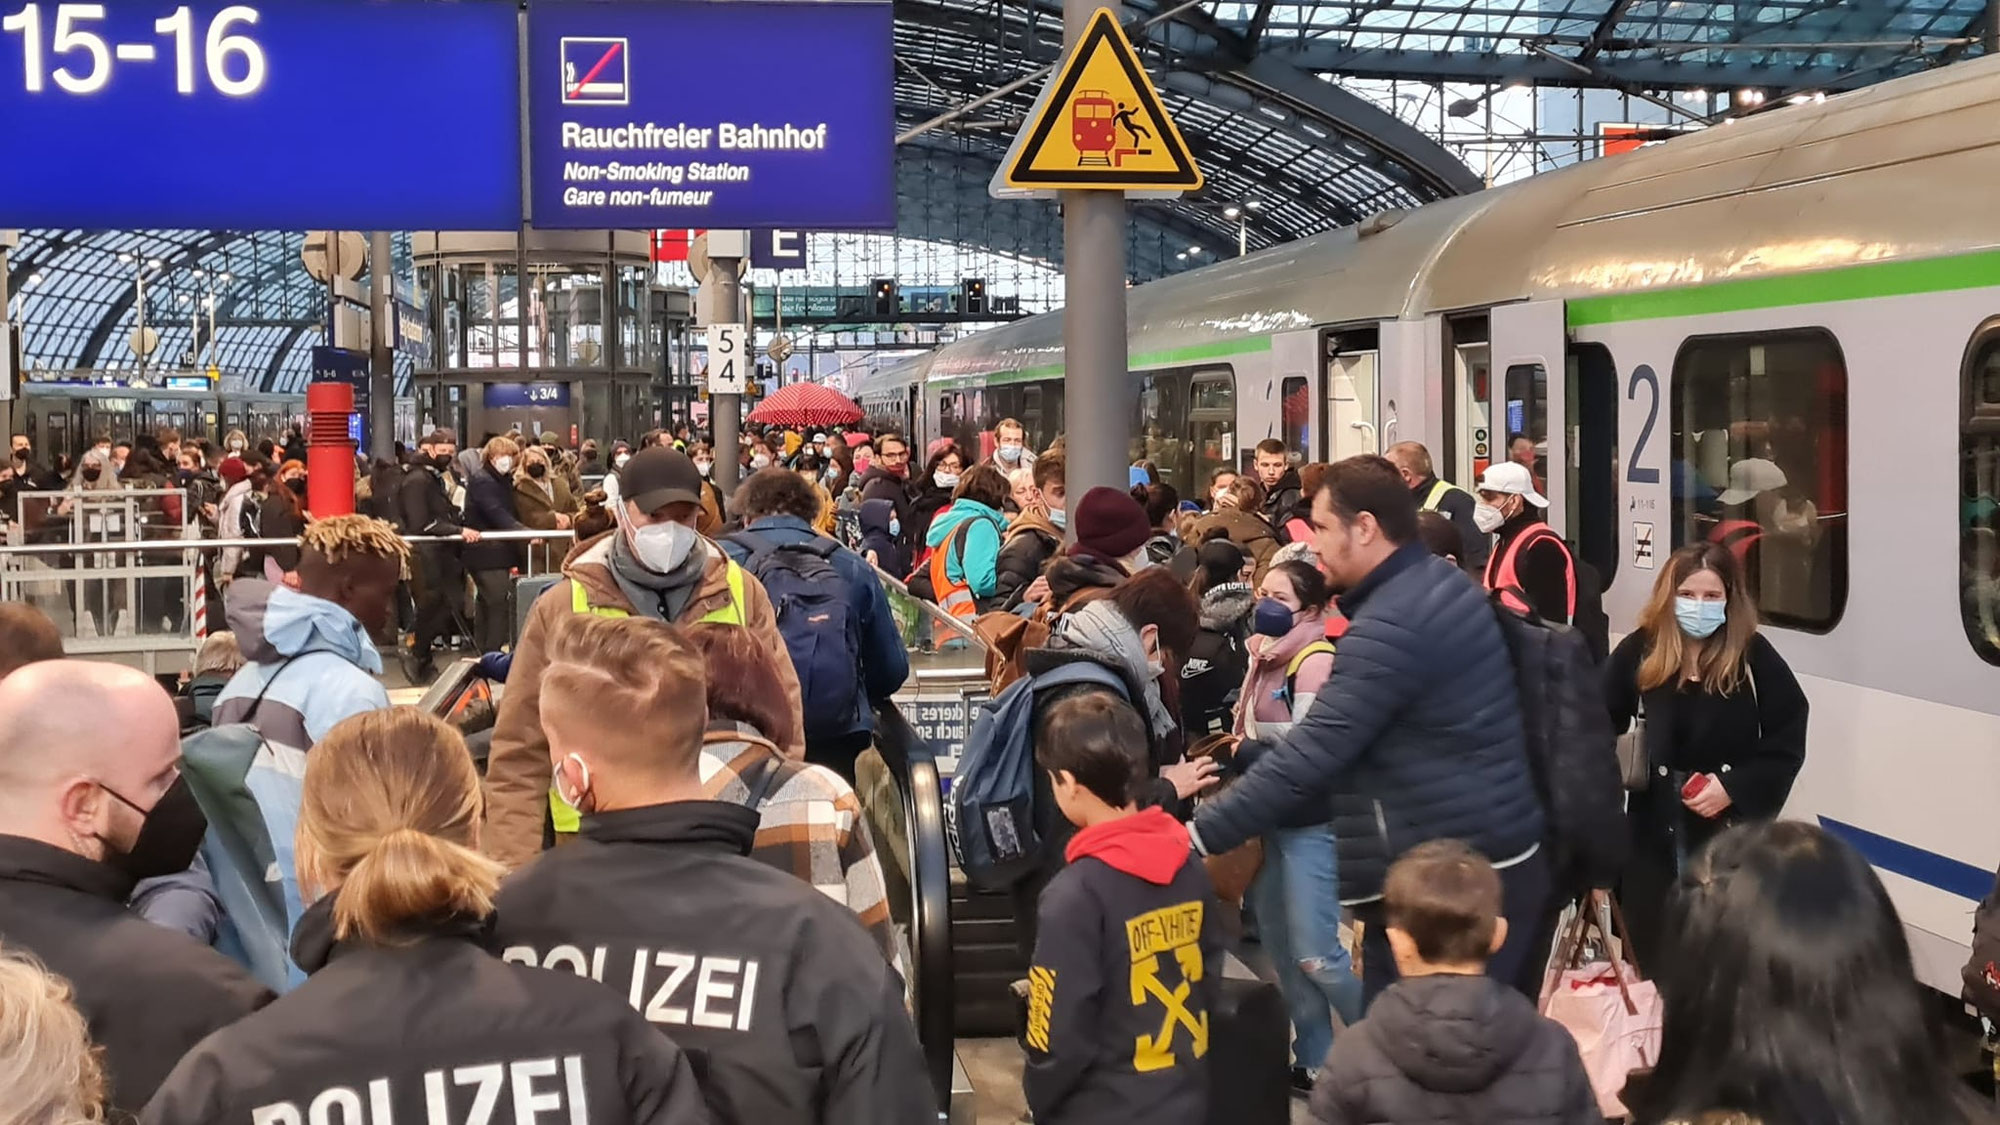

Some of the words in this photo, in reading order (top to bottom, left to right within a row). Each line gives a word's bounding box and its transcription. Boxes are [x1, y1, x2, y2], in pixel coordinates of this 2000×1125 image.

[3, 4, 267, 97] 15-16
[562, 121, 711, 150] Rauchfreier
[719, 122, 827, 150] Bahnhof
[563, 161, 684, 184] Non-Smoking
[687, 162, 749, 182] Station
[563, 187, 606, 206] Gare
[609, 187, 712, 206] non-fumeur
[718, 329, 734, 354] 5
[181, 351, 195, 365] 15
[763, 363, 771, 376] F
[718, 359, 736, 383] 4
[540, 386, 558, 401] 3/4
[1626, 363, 1660, 484] 2
[1187, 657, 1209, 671] NIKE
